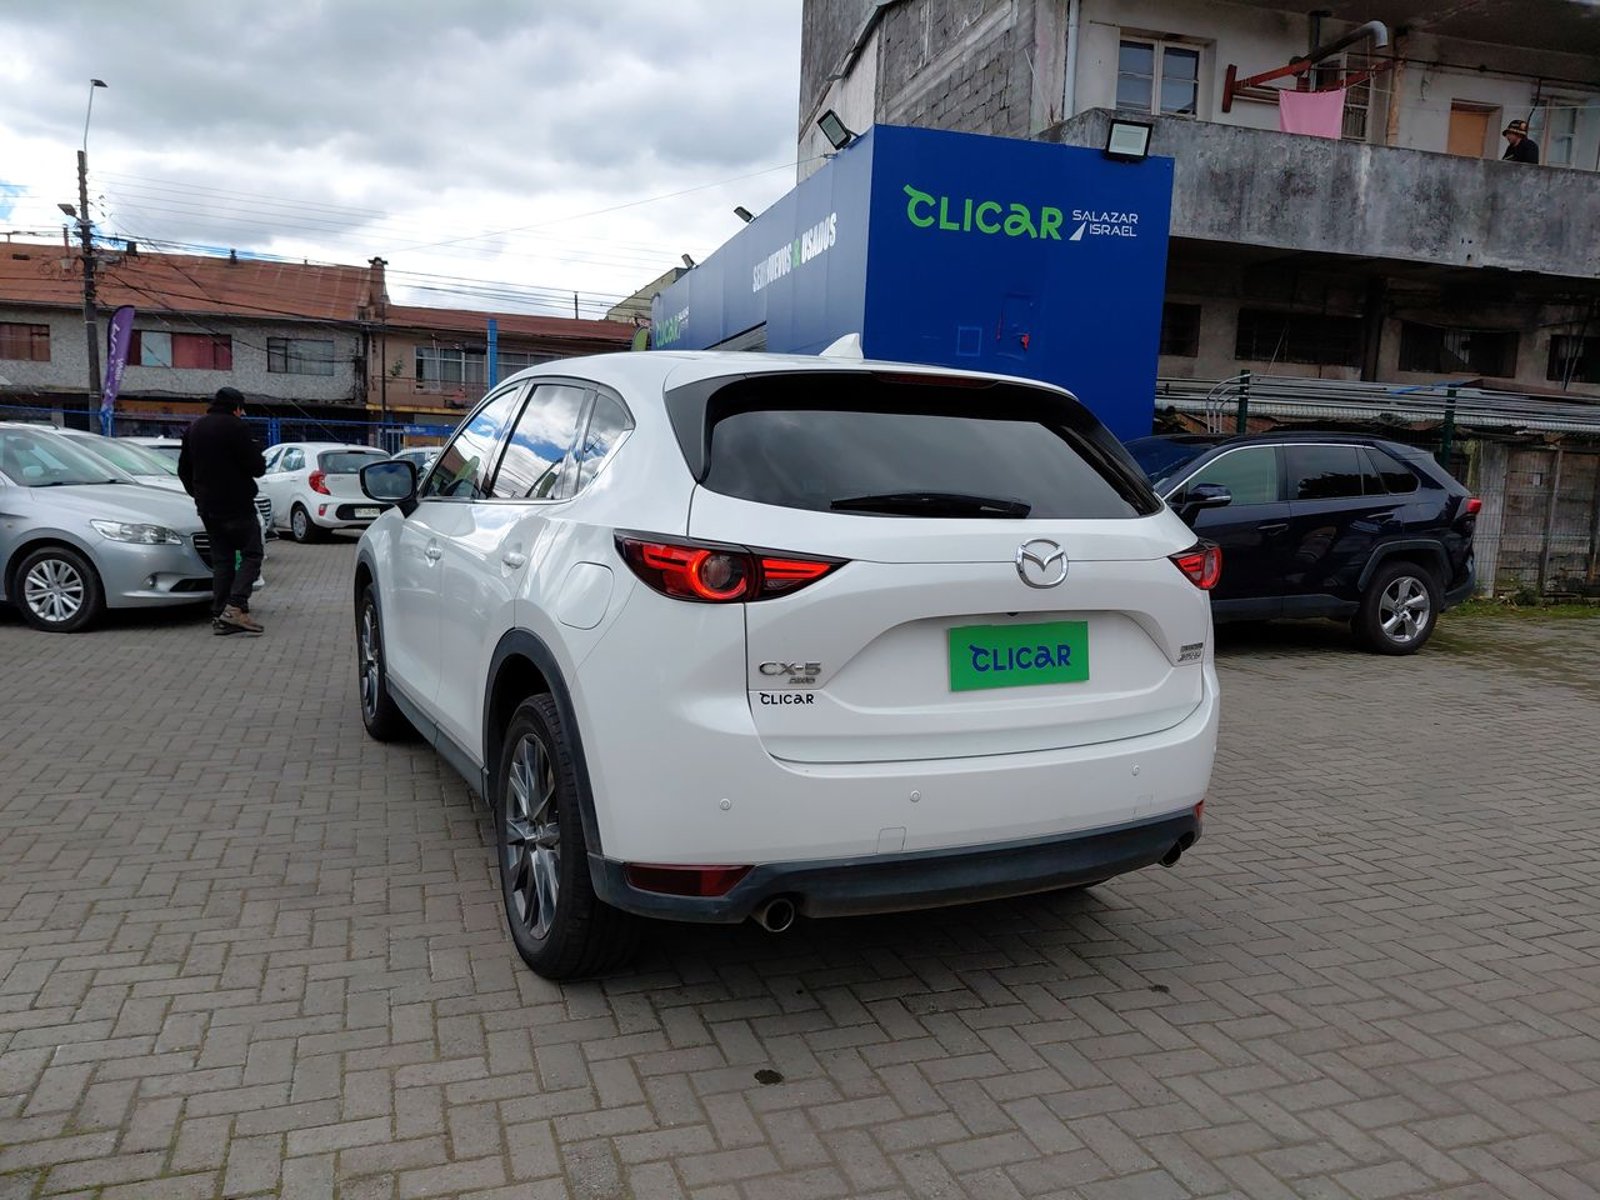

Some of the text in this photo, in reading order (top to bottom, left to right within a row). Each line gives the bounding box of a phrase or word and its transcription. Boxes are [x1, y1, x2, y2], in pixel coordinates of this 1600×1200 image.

[1072, 209, 1139, 224] SALAZAR
[1089, 223, 1138, 237] ISRAEL
[801, 212, 837, 265] USADOS
[759, 661, 821, 676] CX-5
